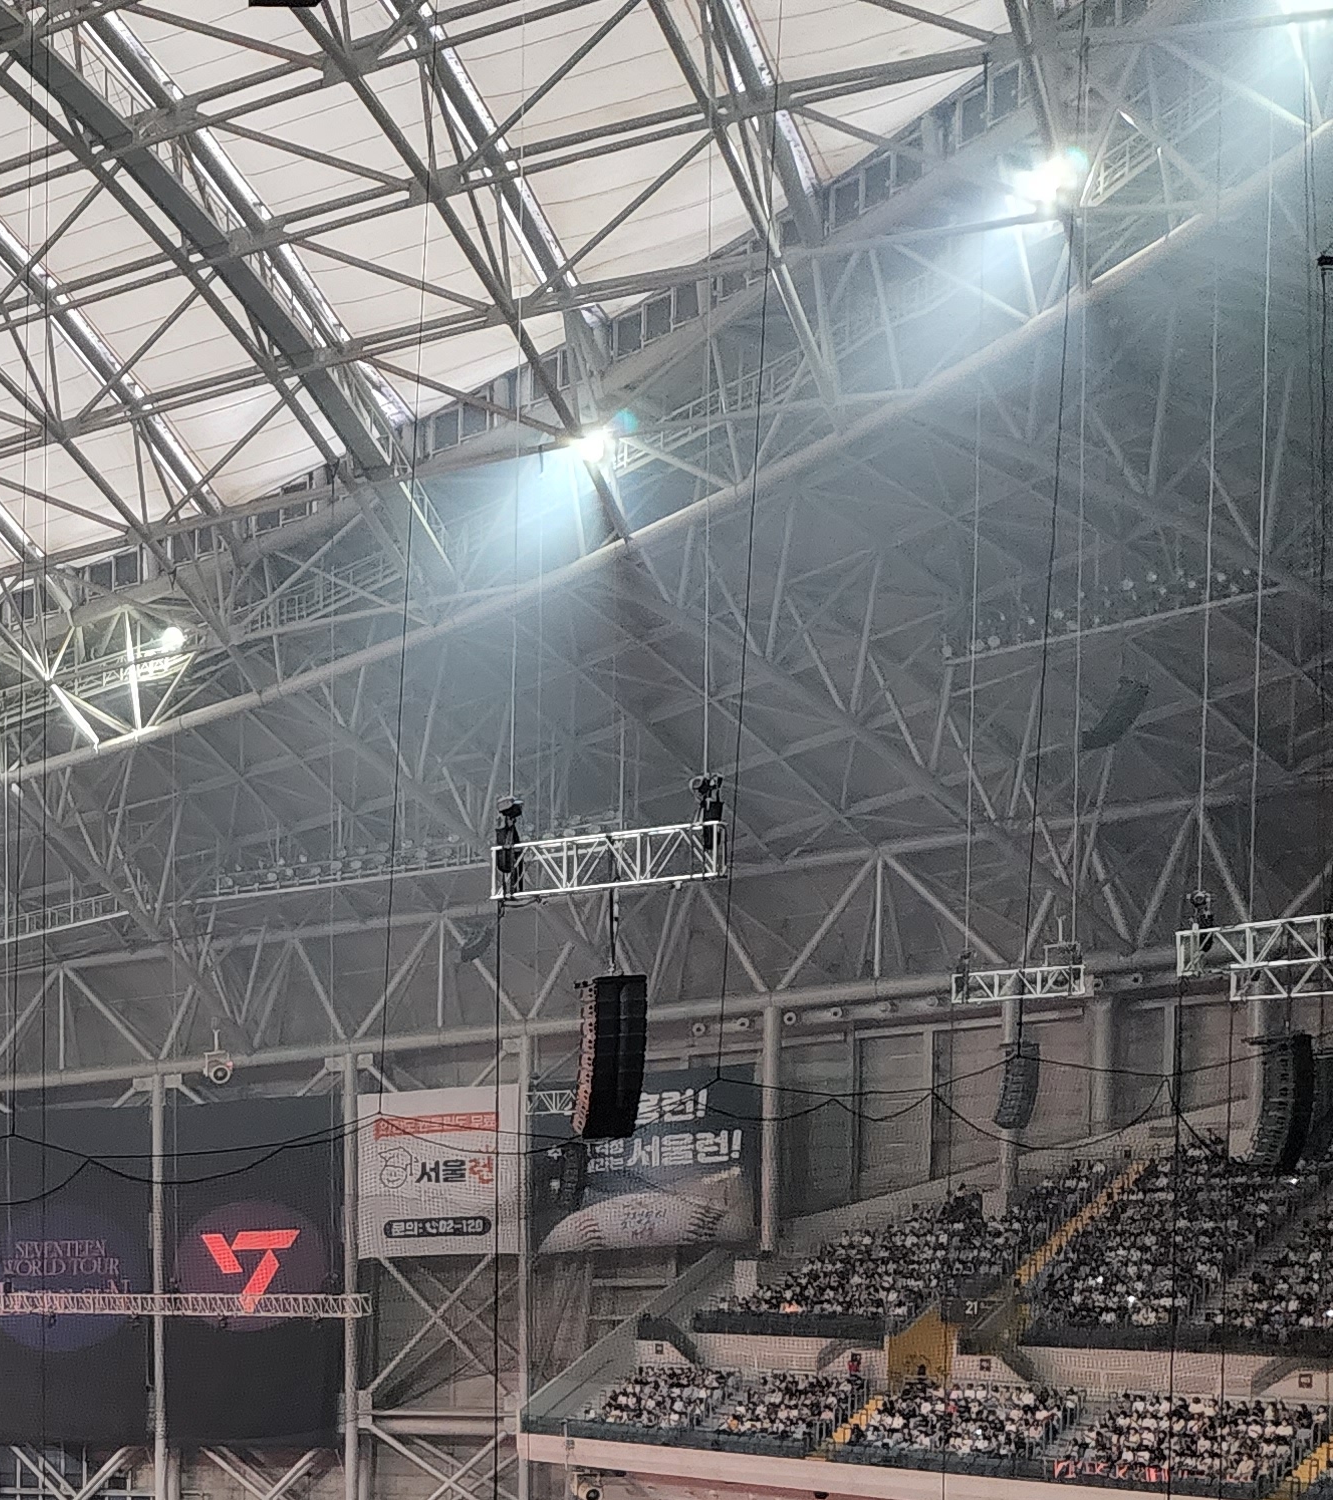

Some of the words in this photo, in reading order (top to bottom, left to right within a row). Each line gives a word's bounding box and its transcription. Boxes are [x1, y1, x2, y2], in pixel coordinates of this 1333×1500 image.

[626, 1129, 742, 1167] 서울런!
[438, 1218, 483, 1233] 02-120
[15, 1239, 107, 1259] SEVENTEEN
[3, 1258, 67, 1277] WORLD
[68, 1257, 120, 1275] TOUR
[965, 1301, 978, 1315] 21
